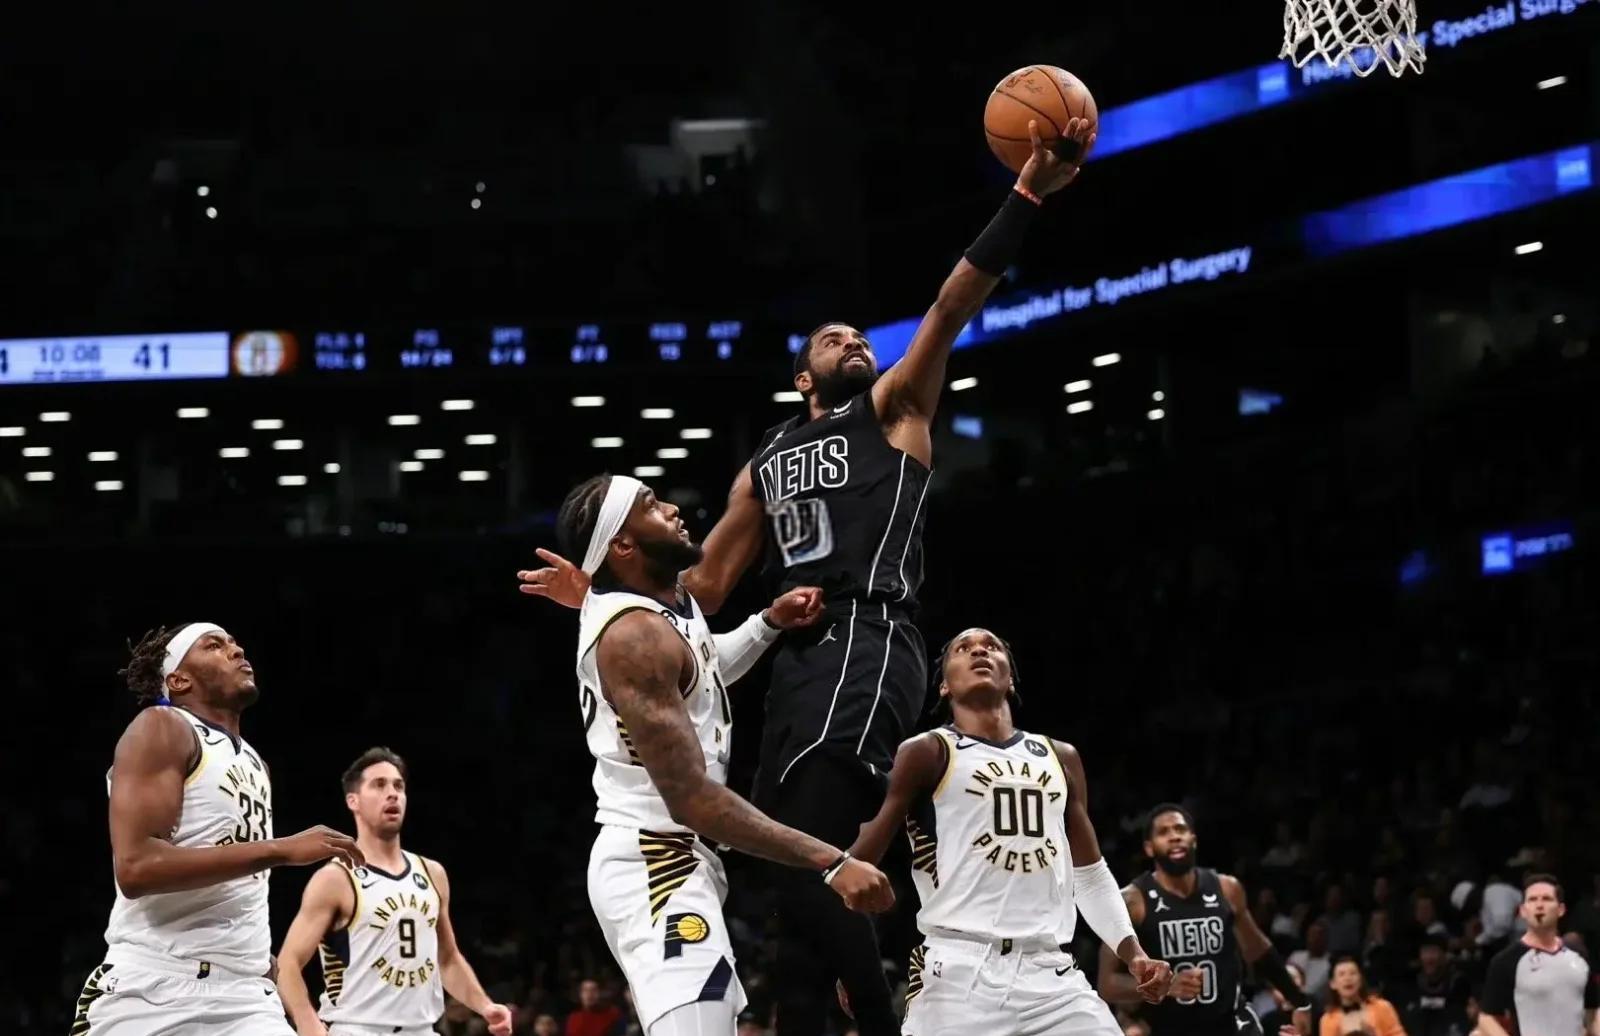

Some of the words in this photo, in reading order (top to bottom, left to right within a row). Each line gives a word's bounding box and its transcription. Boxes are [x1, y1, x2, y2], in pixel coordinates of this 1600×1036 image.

[1432, 1, 1515, 47] Special
[982, 290, 1061, 332] Hospital
[1063, 287, 1092, 312] for
[1095, 263, 1168, 304] Special
[1169, 246, 1252, 284] Surgery
[133, 343, 170, 370] 41
[759, 435, 849, 502] NETS
[965, 760, 1061, 802] INDIANA
[235, 792, 267, 842] 33
[993, 787, 1044, 837] 00
[972, 832, 1058, 873] PACERS
[369, 892, 436, 930] INDIANA
[398, 918, 416, 959] 9
[1159, 916, 1224, 958] NETS
[371, 956, 435, 987] PACERS
